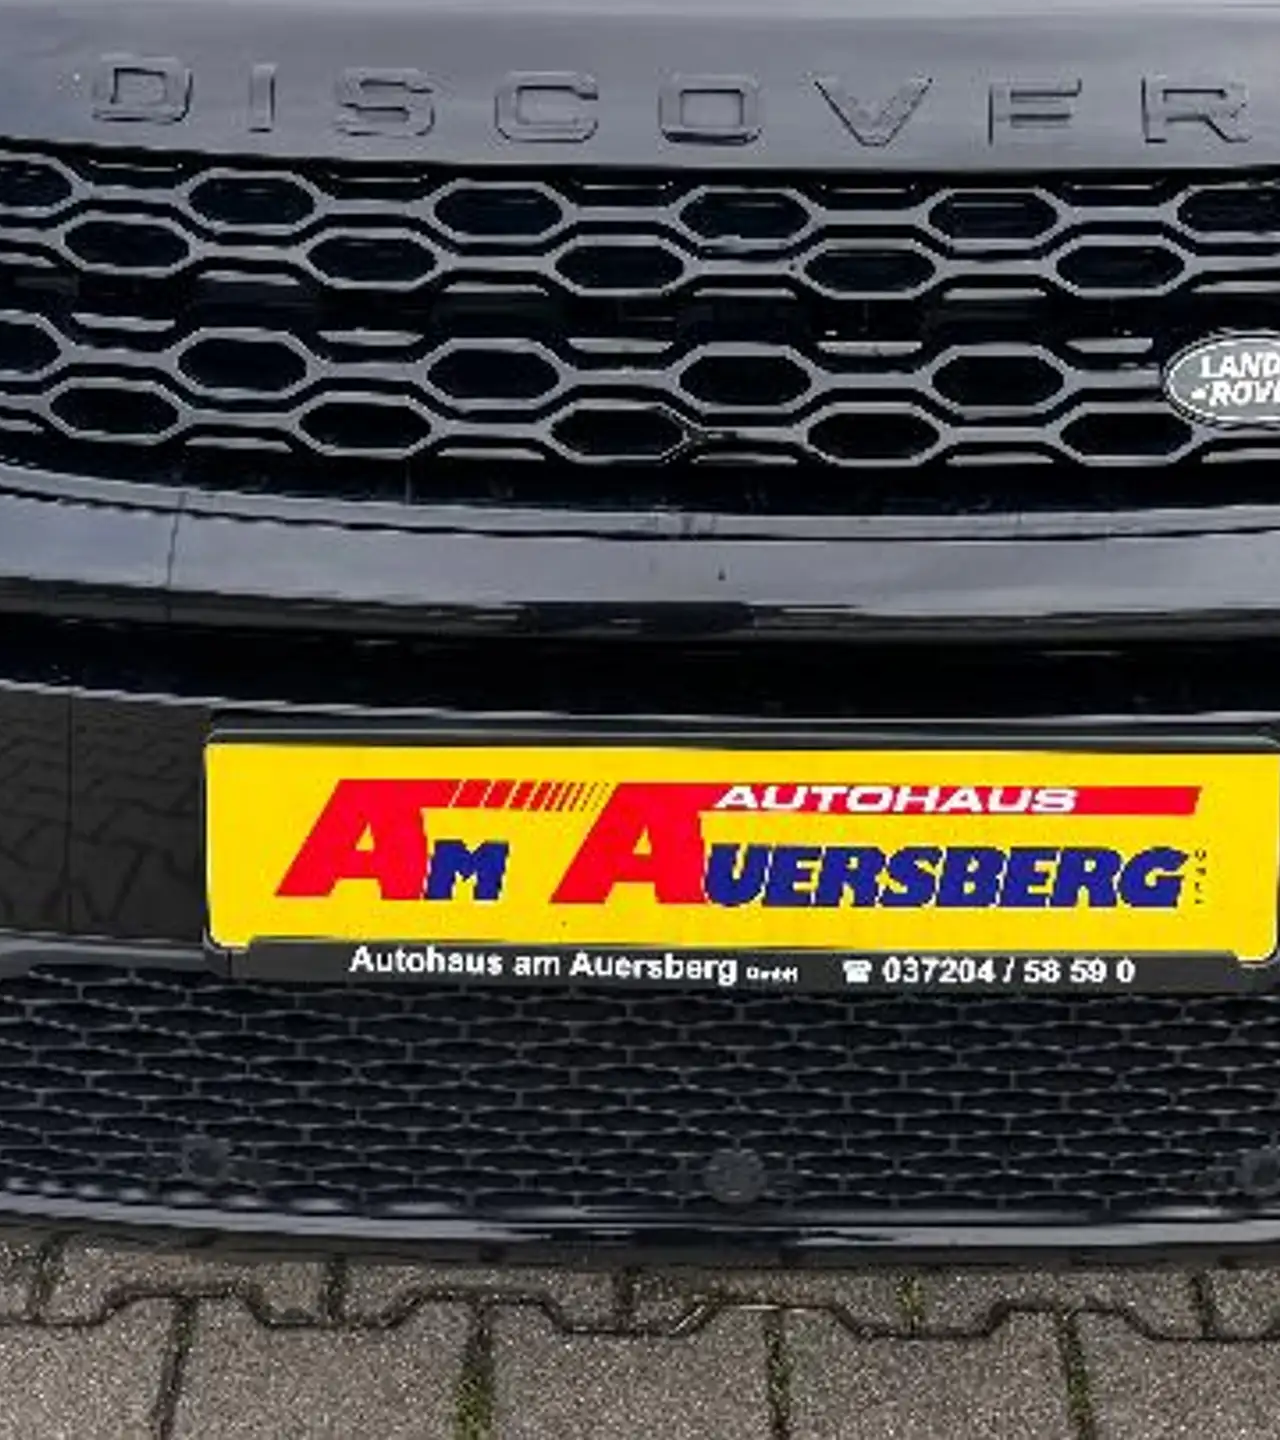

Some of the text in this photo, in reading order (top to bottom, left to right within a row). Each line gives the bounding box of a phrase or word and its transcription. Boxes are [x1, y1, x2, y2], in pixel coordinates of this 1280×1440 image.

[714, 785, 1078, 813] AUTOHAUS
[349, 946, 503, 976] Autohaus
[511, 956, 561, 977] am
[568, 953, 738, 986] Auersberg
[881, 958, 996, 985] 037204
[1023, 958, 1062, 984] 58
[1070, 958, 1108, 984] 59
[1115, 958, 1136, 984] 0
